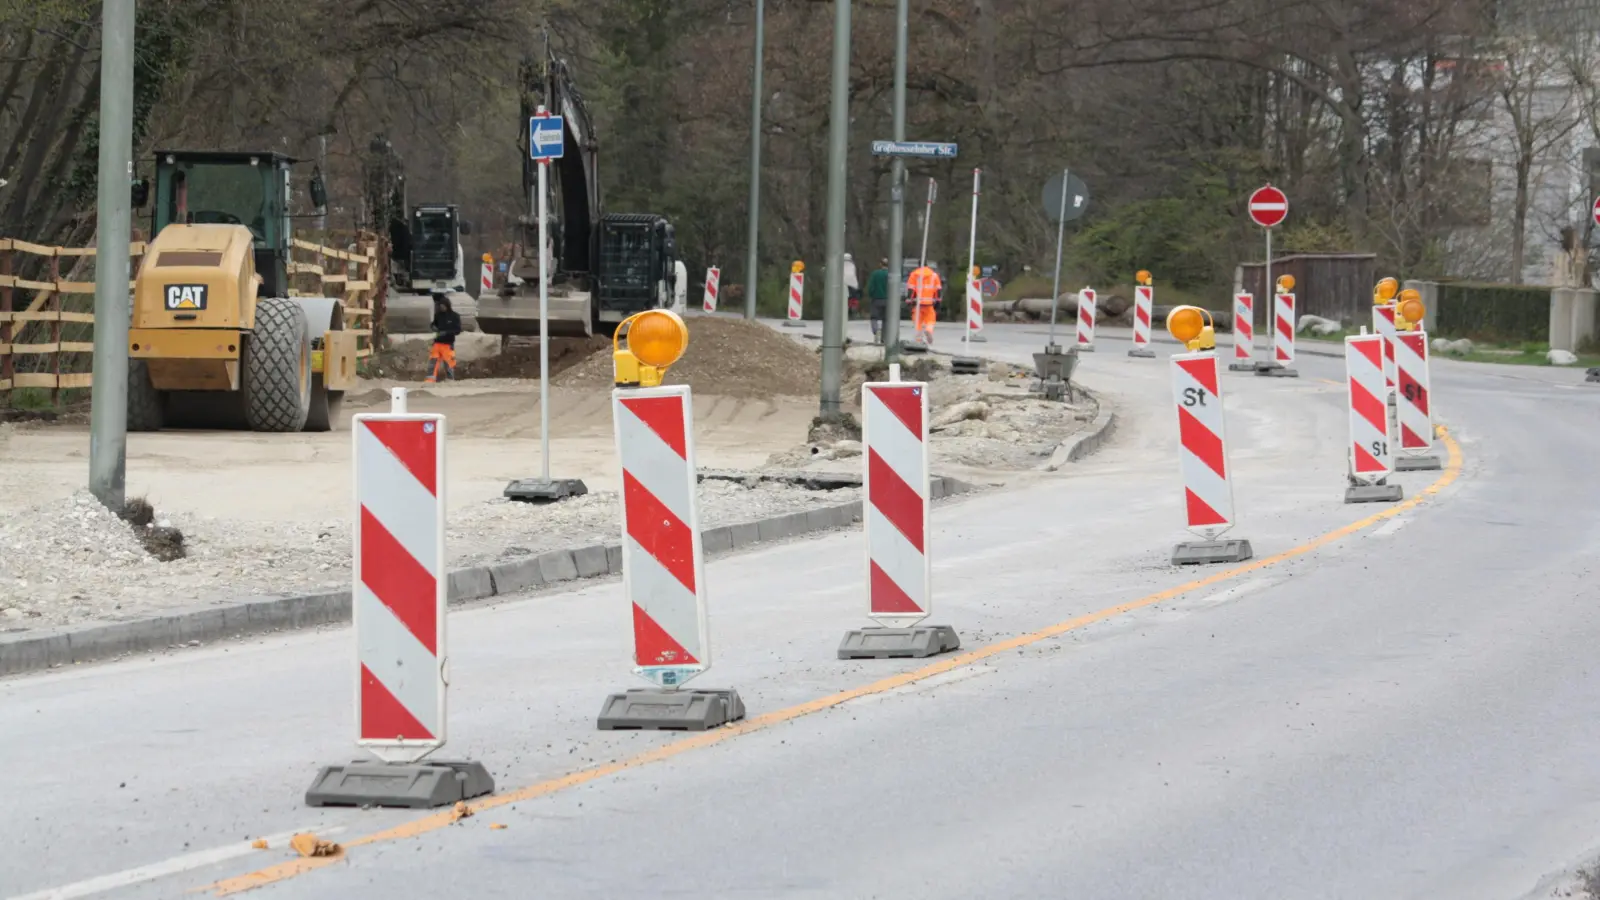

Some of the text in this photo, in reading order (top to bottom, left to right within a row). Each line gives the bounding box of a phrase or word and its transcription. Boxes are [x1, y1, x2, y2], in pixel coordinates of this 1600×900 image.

[938, 144, 953, 155] Str.
[168, 286, 204, 308] CAT
[1183, 387, 1207, 406] St
[1372, 441, 1388, 457] St
